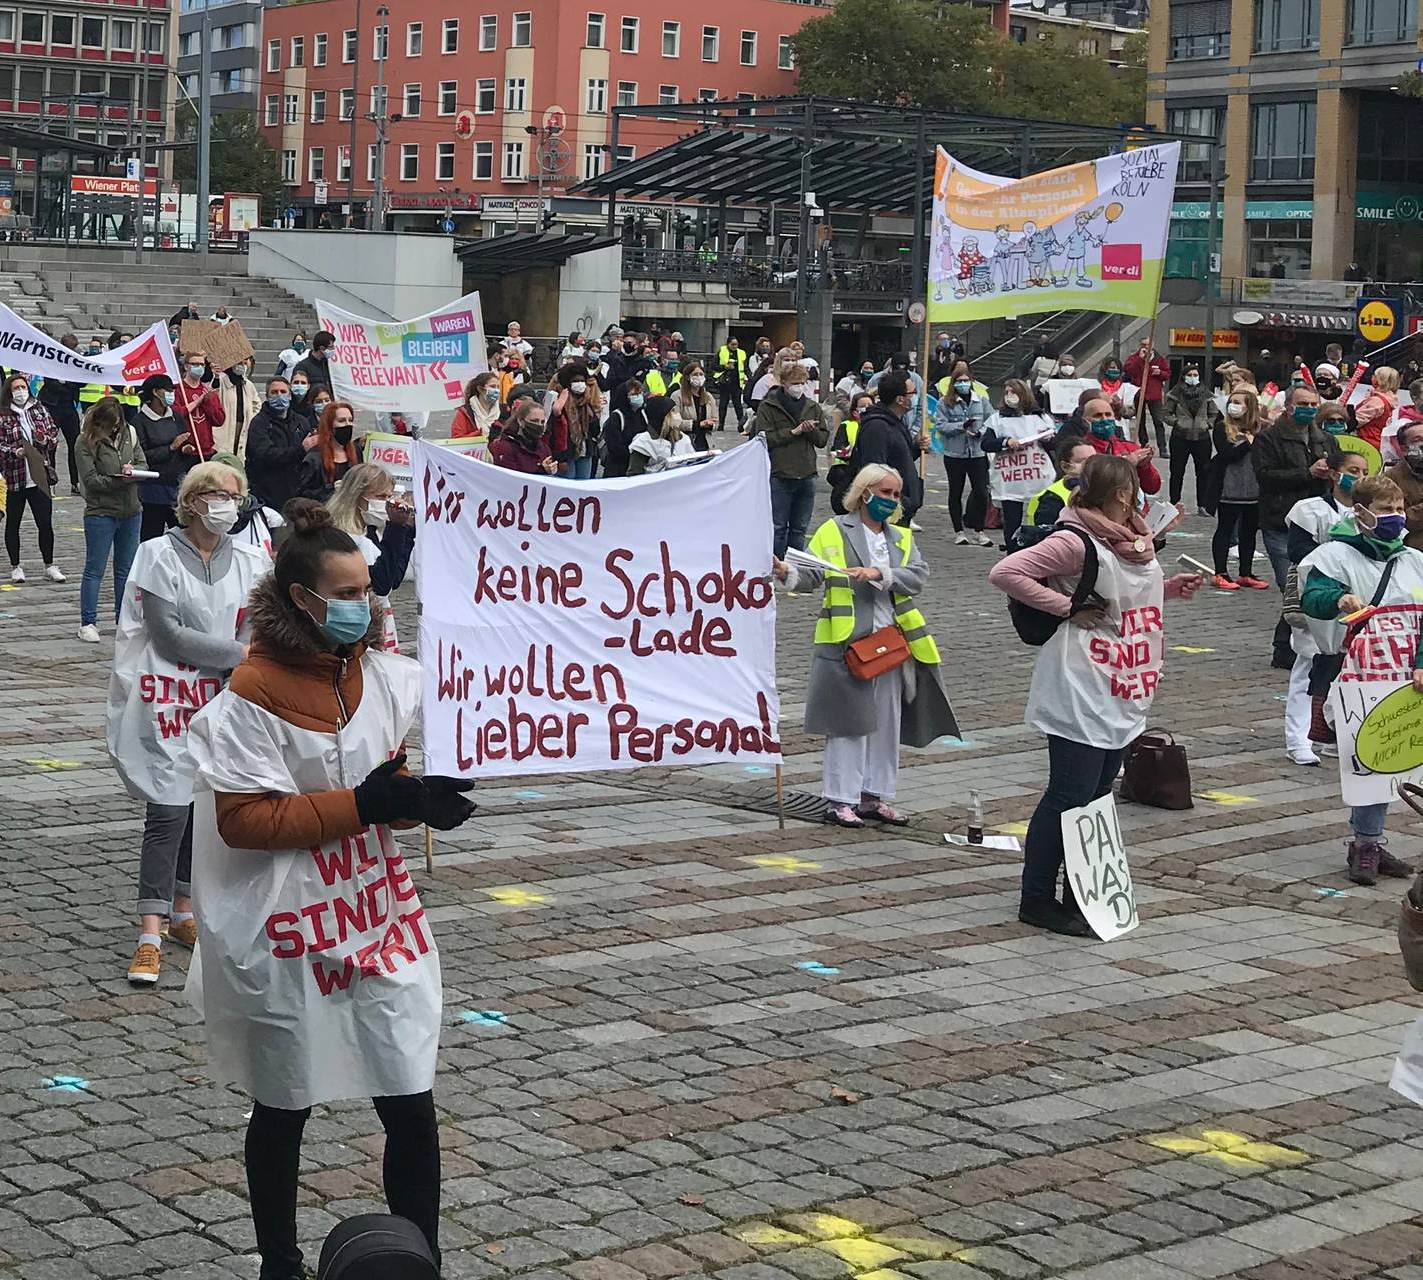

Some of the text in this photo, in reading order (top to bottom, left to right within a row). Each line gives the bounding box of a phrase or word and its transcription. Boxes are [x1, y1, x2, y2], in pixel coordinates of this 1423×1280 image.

[84, 179, 119, 191] Wiener
[518, 201, 546, 209] CONCOD
[1245, 209, 1272, 218] SMILE
[1356, 207, 1395, 220] SMILE
[1104, 264, 1139, 277] ver.di
[434, 316, 471, 333] WAREN
[407, 340, 463, 357] BLEIBEN
[422, 460, 602, 536] Wir wollen
[475, 540, 776, 621] keine Schoko
[437, 636, 628, 705] Wir wollen
[1110, 670, 1159, 700] WER
[606, 690, 781, 764] Personal
[264, 878, 391, 960] SIND
